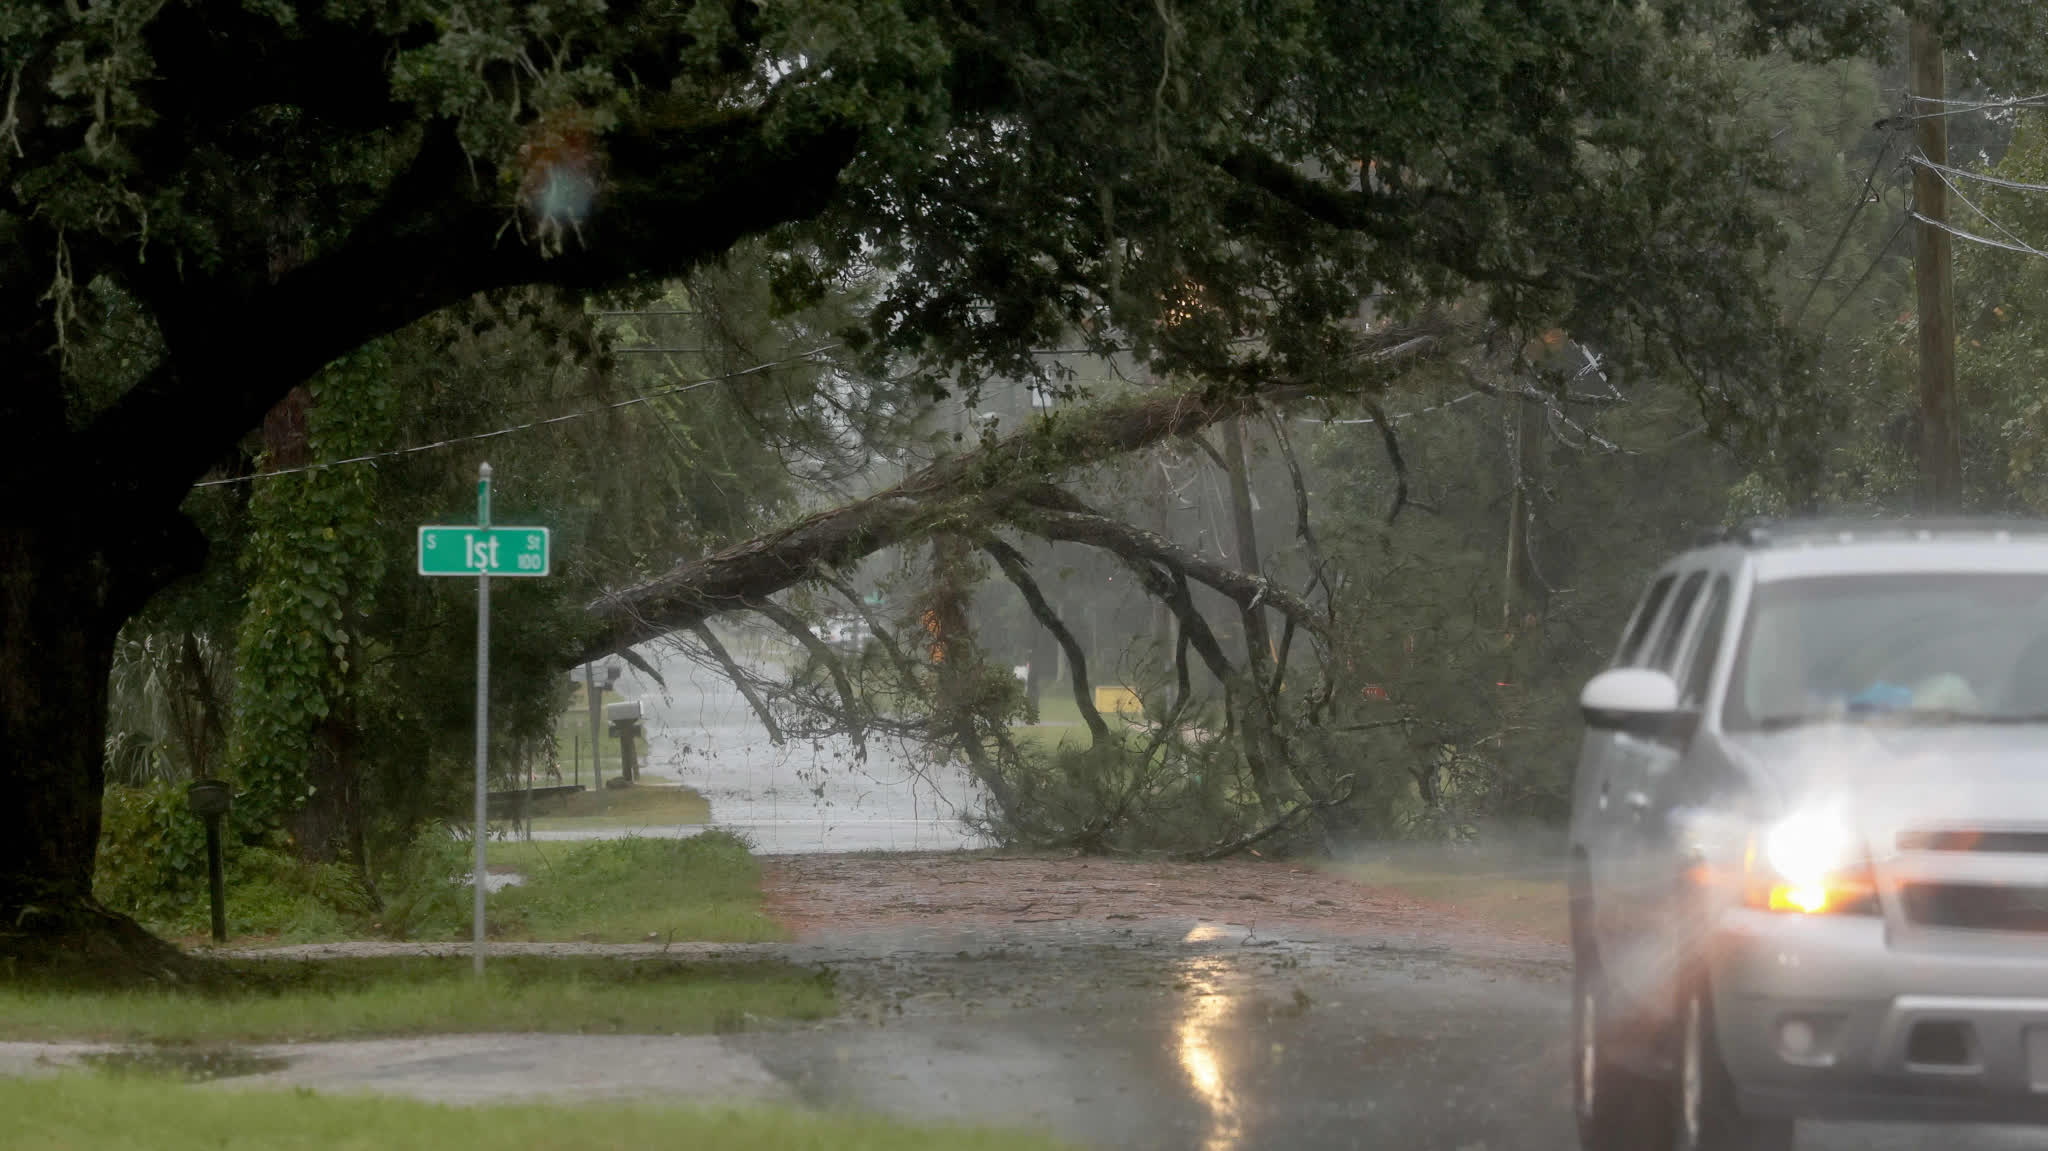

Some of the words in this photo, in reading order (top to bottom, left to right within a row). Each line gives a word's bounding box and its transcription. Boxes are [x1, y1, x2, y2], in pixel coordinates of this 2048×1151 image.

[426, 534, 437, 549] S
[464, 534, 500, 568] 1st
[527, 534, 541, 550] St
[517, 554, 541, 570] 100
